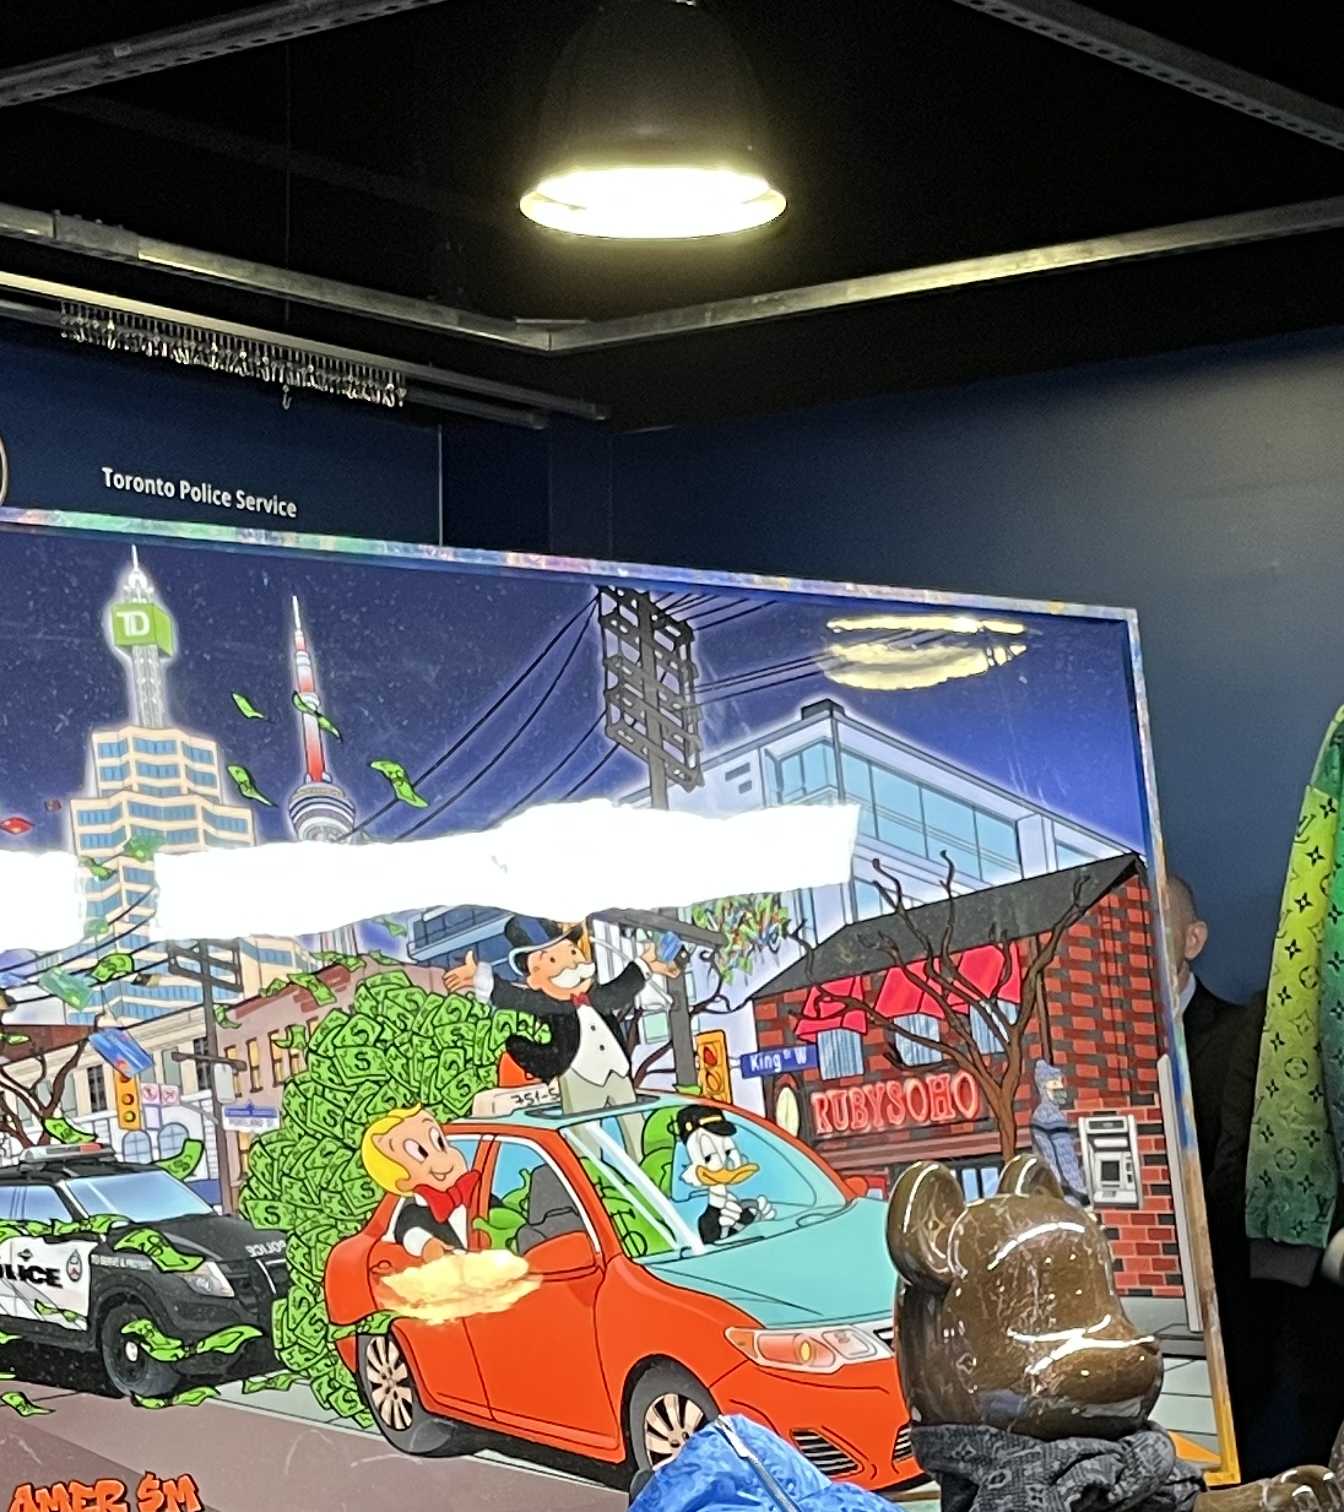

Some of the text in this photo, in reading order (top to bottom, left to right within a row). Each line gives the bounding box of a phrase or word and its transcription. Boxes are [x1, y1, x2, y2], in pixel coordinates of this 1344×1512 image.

[101, 466, 297, 518] Toronto Police Service
[116, 611, 150, 636] TD
[750, 1054, 781, 1073] King
[795, 1047, 807, 1065] W
[812, 1070, 980, 1135] RUBYSOHO
